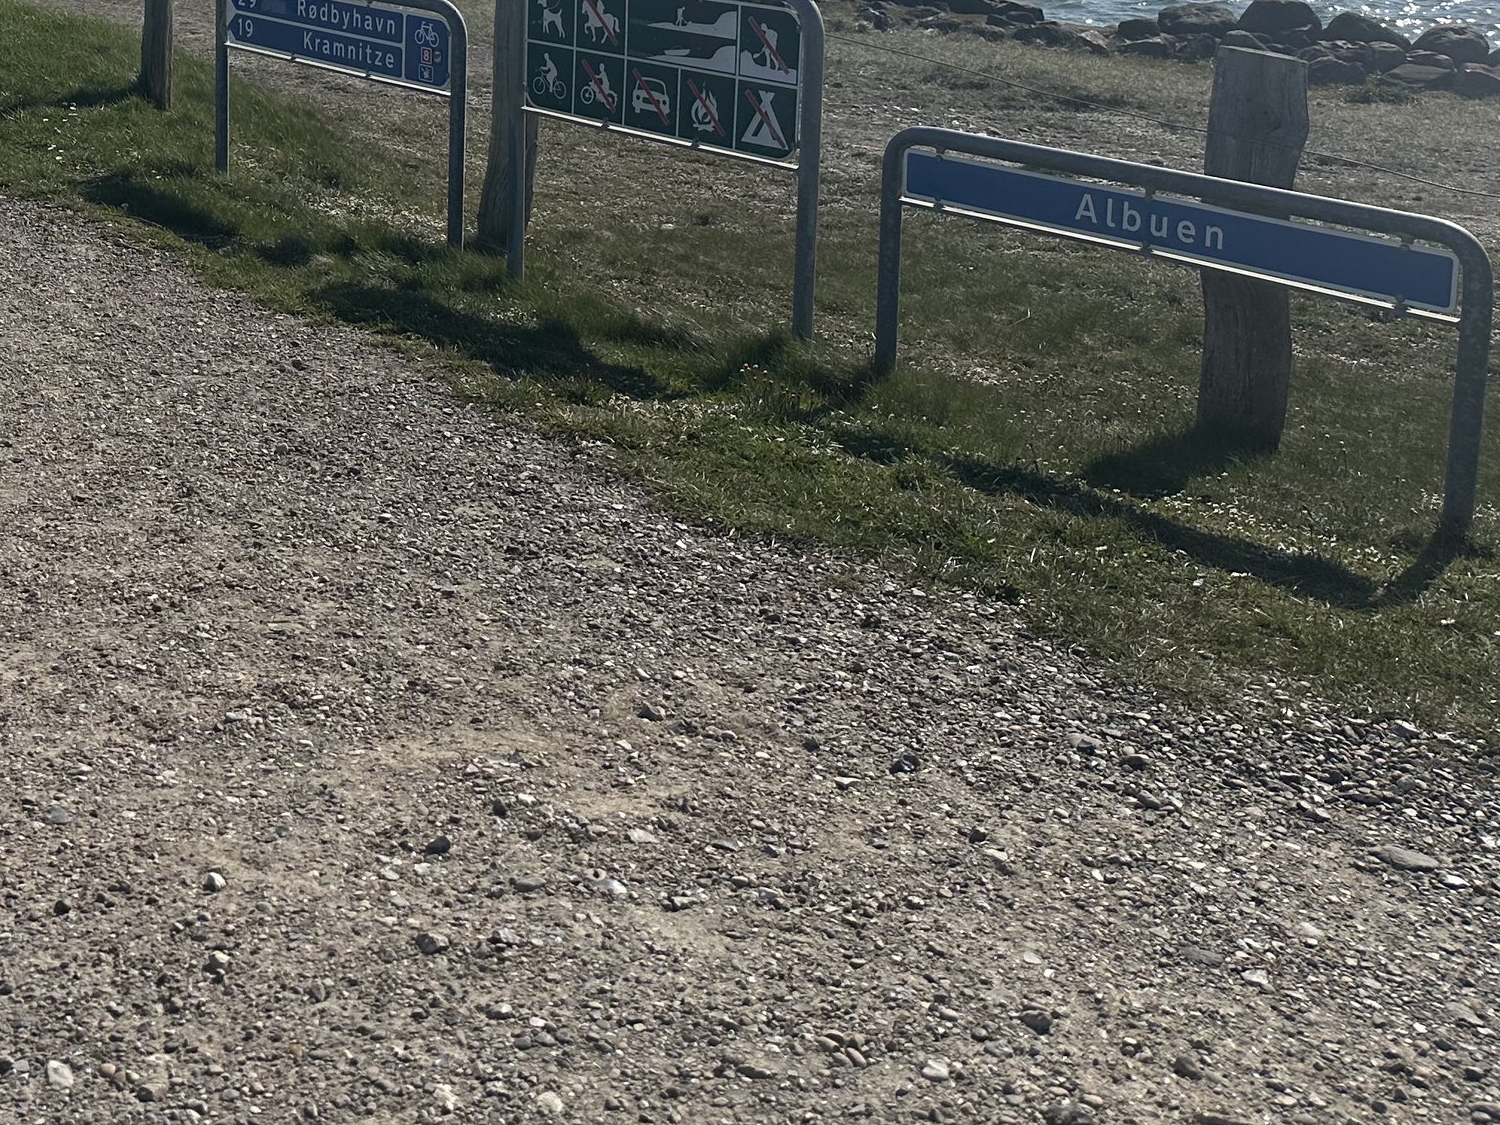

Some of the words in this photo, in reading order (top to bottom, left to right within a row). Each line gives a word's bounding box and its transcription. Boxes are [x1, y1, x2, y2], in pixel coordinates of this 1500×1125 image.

[238, 18, 254, 37] 19
[303, 30, 395, 69] Kramnitze
[423, 49, 430, 61] 8
[1075, 193, 1224, 250] Albuen
